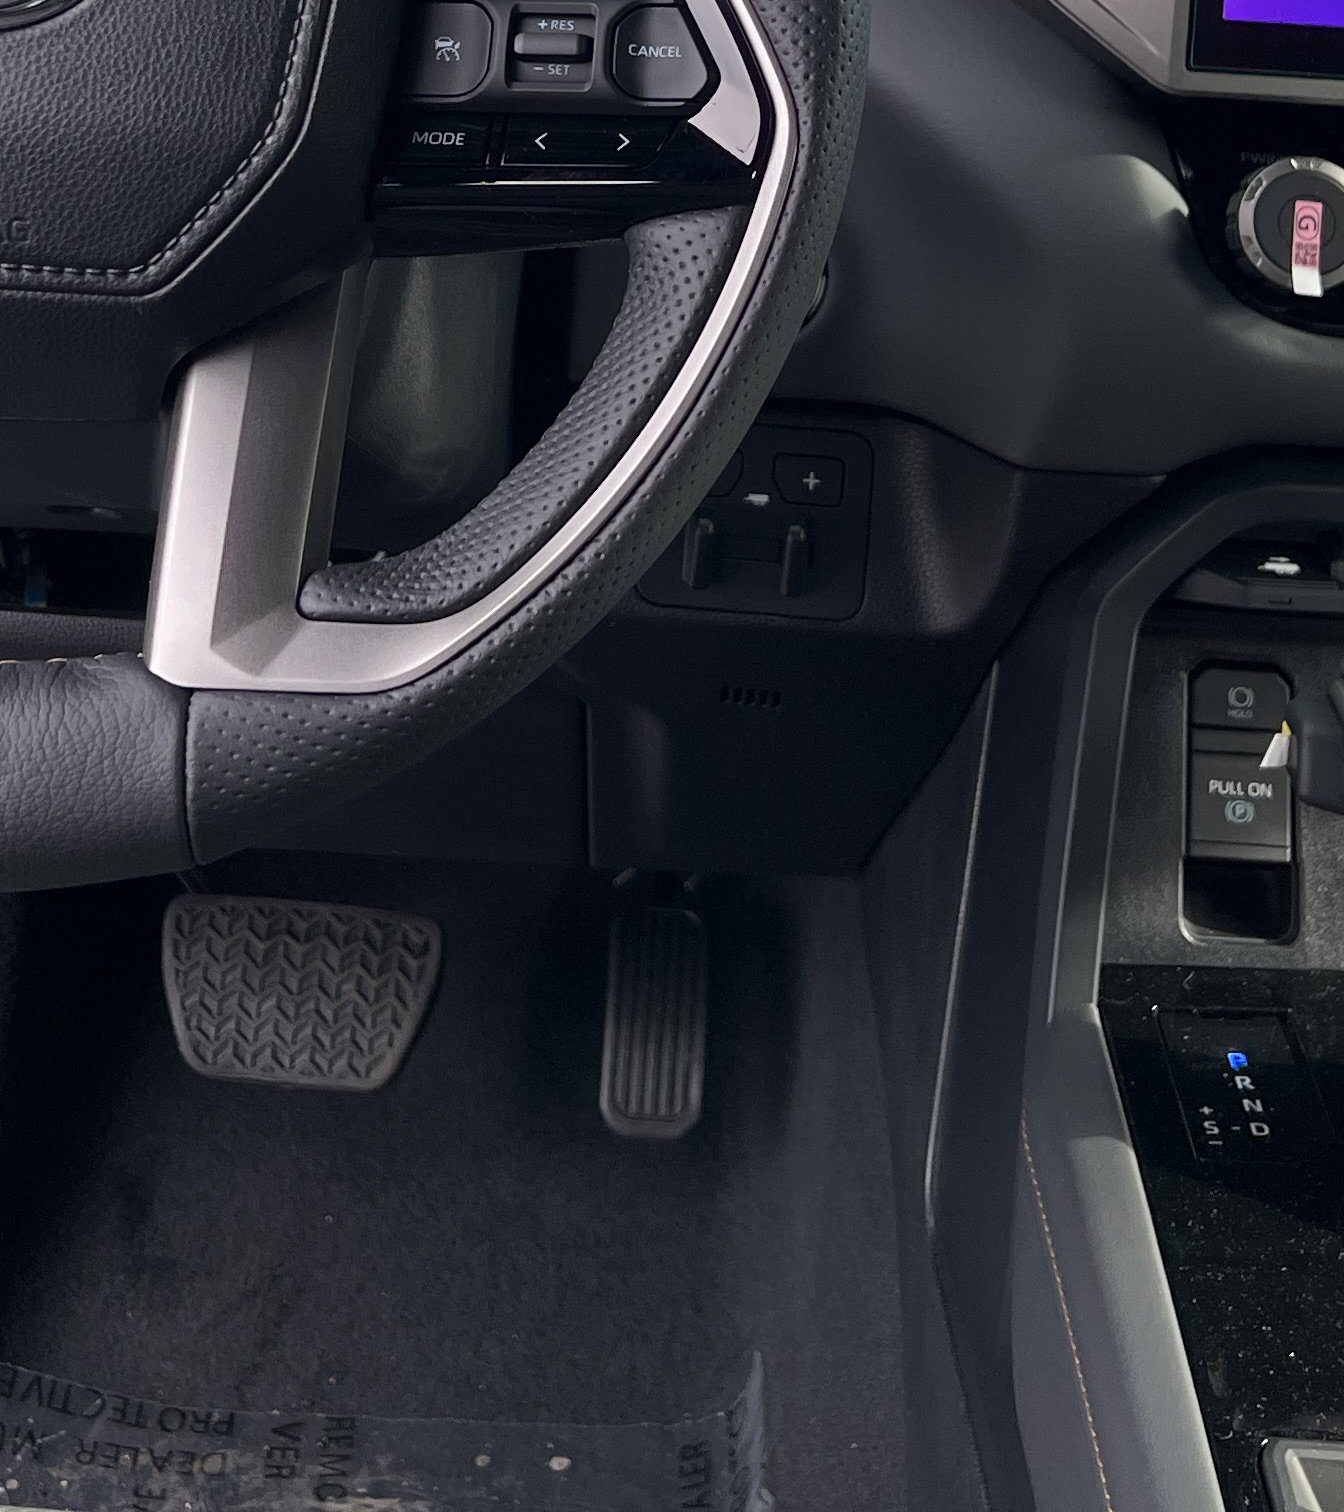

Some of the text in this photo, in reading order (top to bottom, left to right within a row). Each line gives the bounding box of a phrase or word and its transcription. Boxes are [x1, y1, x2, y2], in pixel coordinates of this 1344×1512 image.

[628, 43, 683, 59] CANCEL
[412, 131, 466, 147] MODE
[1208, 779, 1273, 798] PULL ON
[1235, 1075, 1256, 1090] R
[1242, 1098, 1264, 1113] N
[1203, 1120, 1270, 1136] S D
[74, 1436, 229, 1480] DEALER
